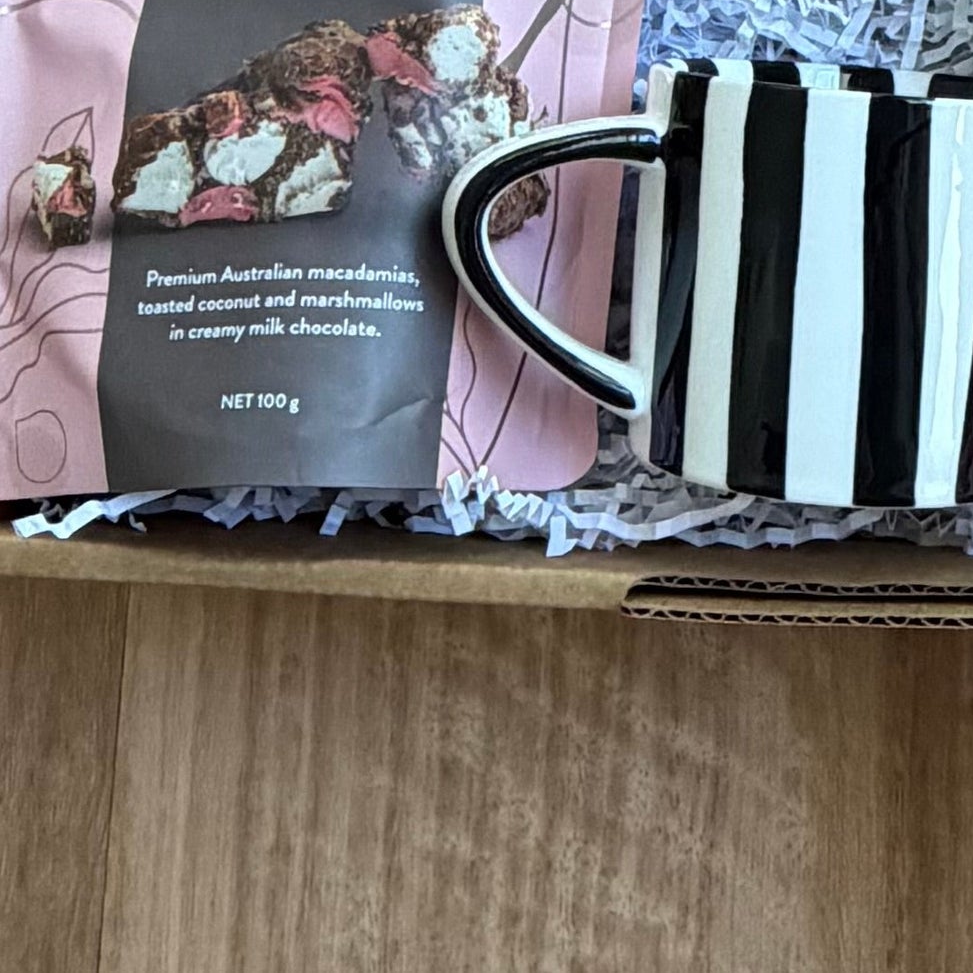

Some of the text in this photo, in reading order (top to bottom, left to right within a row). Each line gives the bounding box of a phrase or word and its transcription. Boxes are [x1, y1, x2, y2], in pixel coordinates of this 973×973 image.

[146, 263, 420, 287] Premium Australian macadamias,
[138, 290, 424, 315] toasted coconut and marshmallows
[169, 317, 382, 343] in creamy milk chocolate.
[220, 393, 254, 409] NET
